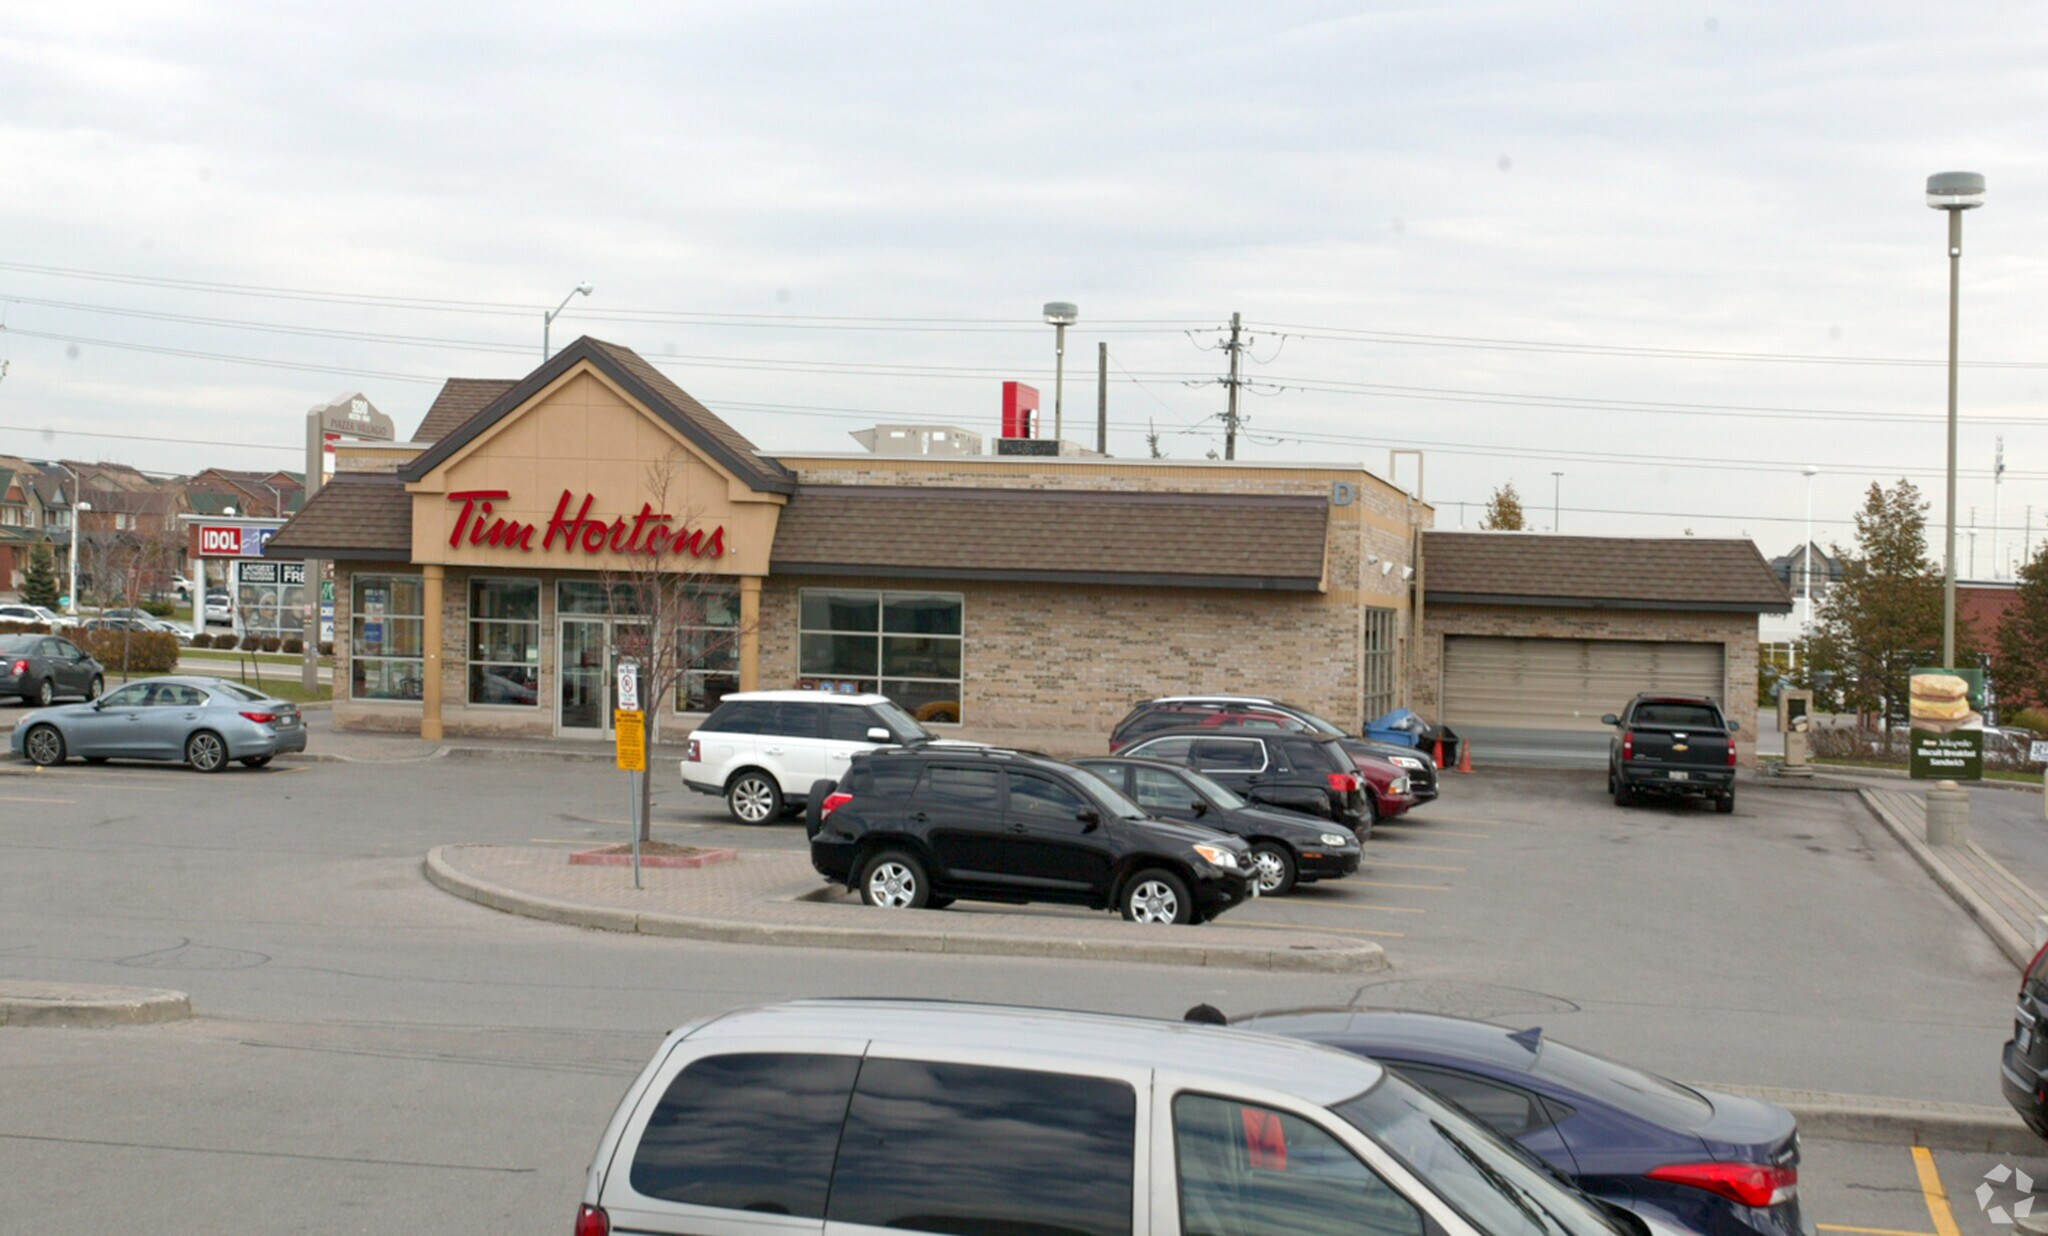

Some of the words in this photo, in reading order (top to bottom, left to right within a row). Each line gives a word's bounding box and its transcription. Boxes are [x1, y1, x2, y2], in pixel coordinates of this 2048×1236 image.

[1333, 482, 1355, 506] D
[447, 489, 534, 550] Tim
[541, 488, 725, 559] Hortons
[203, 531, 239, 551] IDOL
[1917, 747, 1942, 757] Biscuit
[1943, 748, 1977, 758] Breakfast
[1929, 757, 1966, 767] Sandwich
